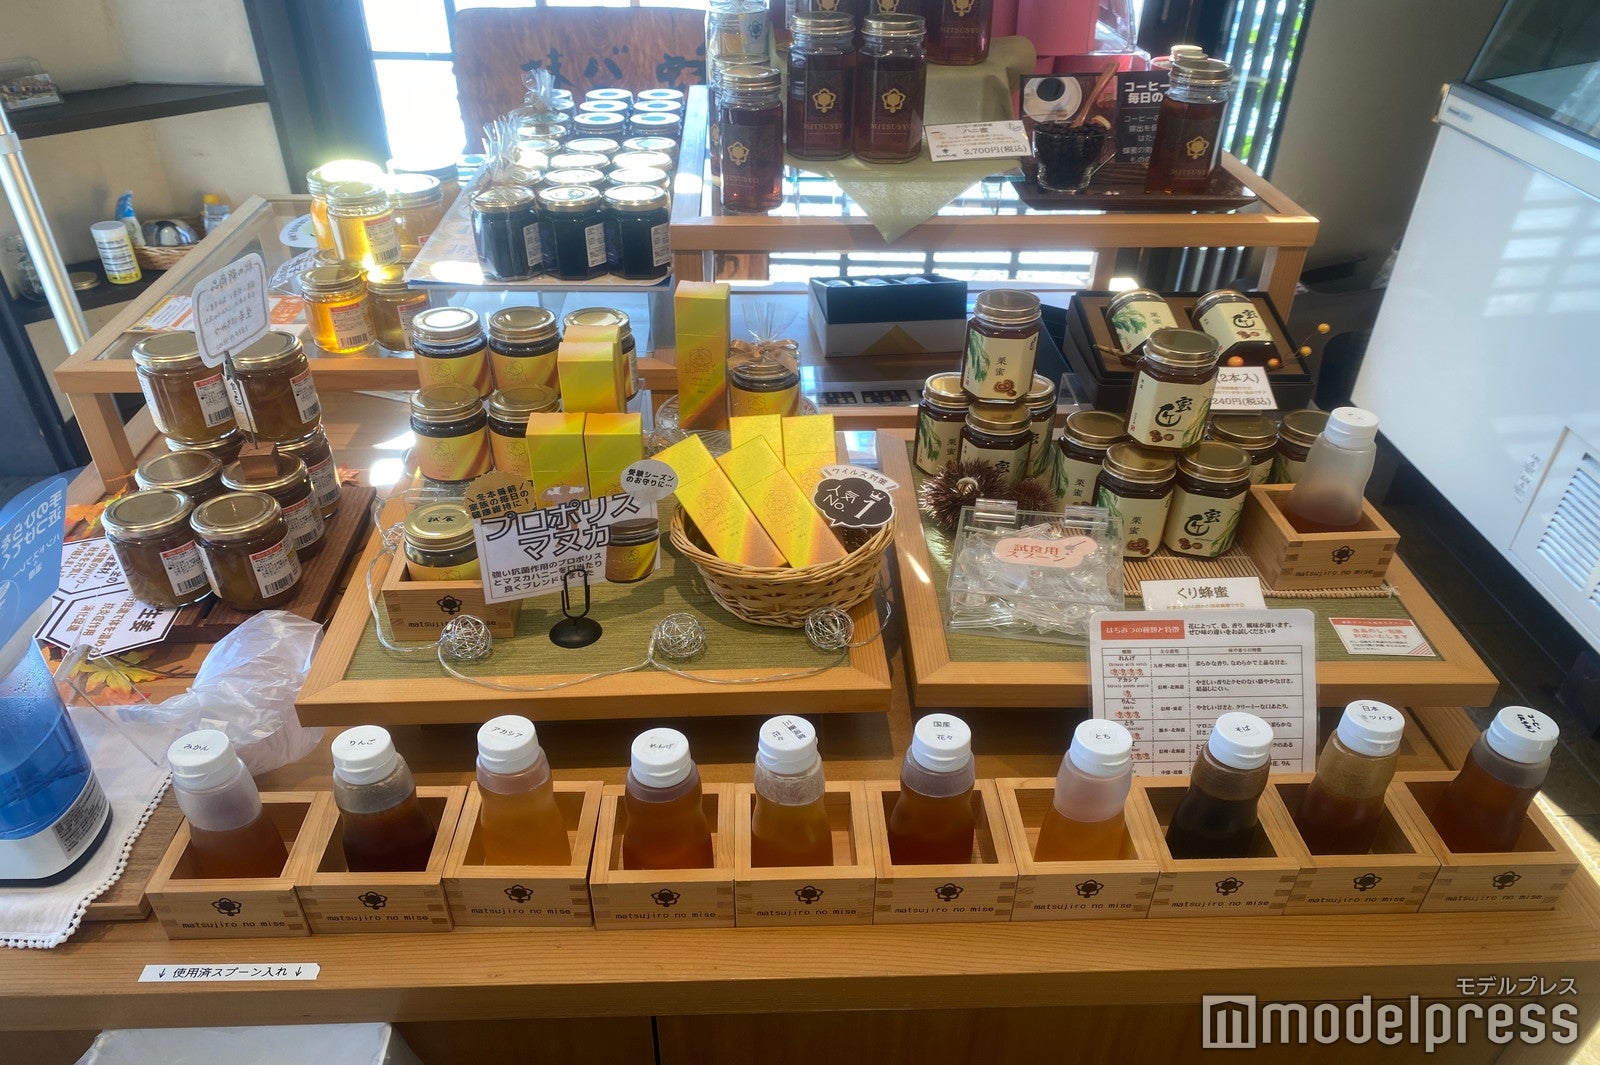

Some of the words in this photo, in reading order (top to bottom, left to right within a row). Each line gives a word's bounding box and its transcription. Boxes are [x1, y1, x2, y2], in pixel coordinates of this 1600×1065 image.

[1128, 92, 1164, 104] 毎日の
[964, 146, 1028, 156] 2,700円(税込)
[628, 468, 675, 482] 受験シーズン
[476, 485, 517, 500] 冬本番前
[826, 485, 860, 504] 人気
[468, 490, 529, 512] 家族の毎日の
[822, 494, 845, 512] No.
[854, 498, 876, 520] 1
[481, 492, 640, 542] プロポリス
[519, 524, 611, 562] マヌカ
[1012, 543, 1060, 557] 試食用
[492, 553, 602, 578] 強い抗菌作用のプロポリス
[1178, 586, 1230, 599] くり蜂蜜
[1106, 626, 1180, 634] はちみつの種類と特徴
[1362, 704, 1379, 712] 日本
[491, 727, 524, 738] アカシア
[183, 744, 210, 752] みかん
[1308, 896, 1360, 904] matsujiro
[1445, 894, 1498, 902] matsujiro
[1034, 903, 1086, 911] matsujiro
[1171, 900, 1224, 908] matsujiro
[470, 908, 524, 916] matsujiro
[756, 909, 810, 917] matsujiro
[894, 906, 948, 914] matsujiro
[326, 914, 382, 922] matsujiro
[182, 921, 238, 929] matsujiro
[172, 967, 288, 978] 使用済スプーン入れ
